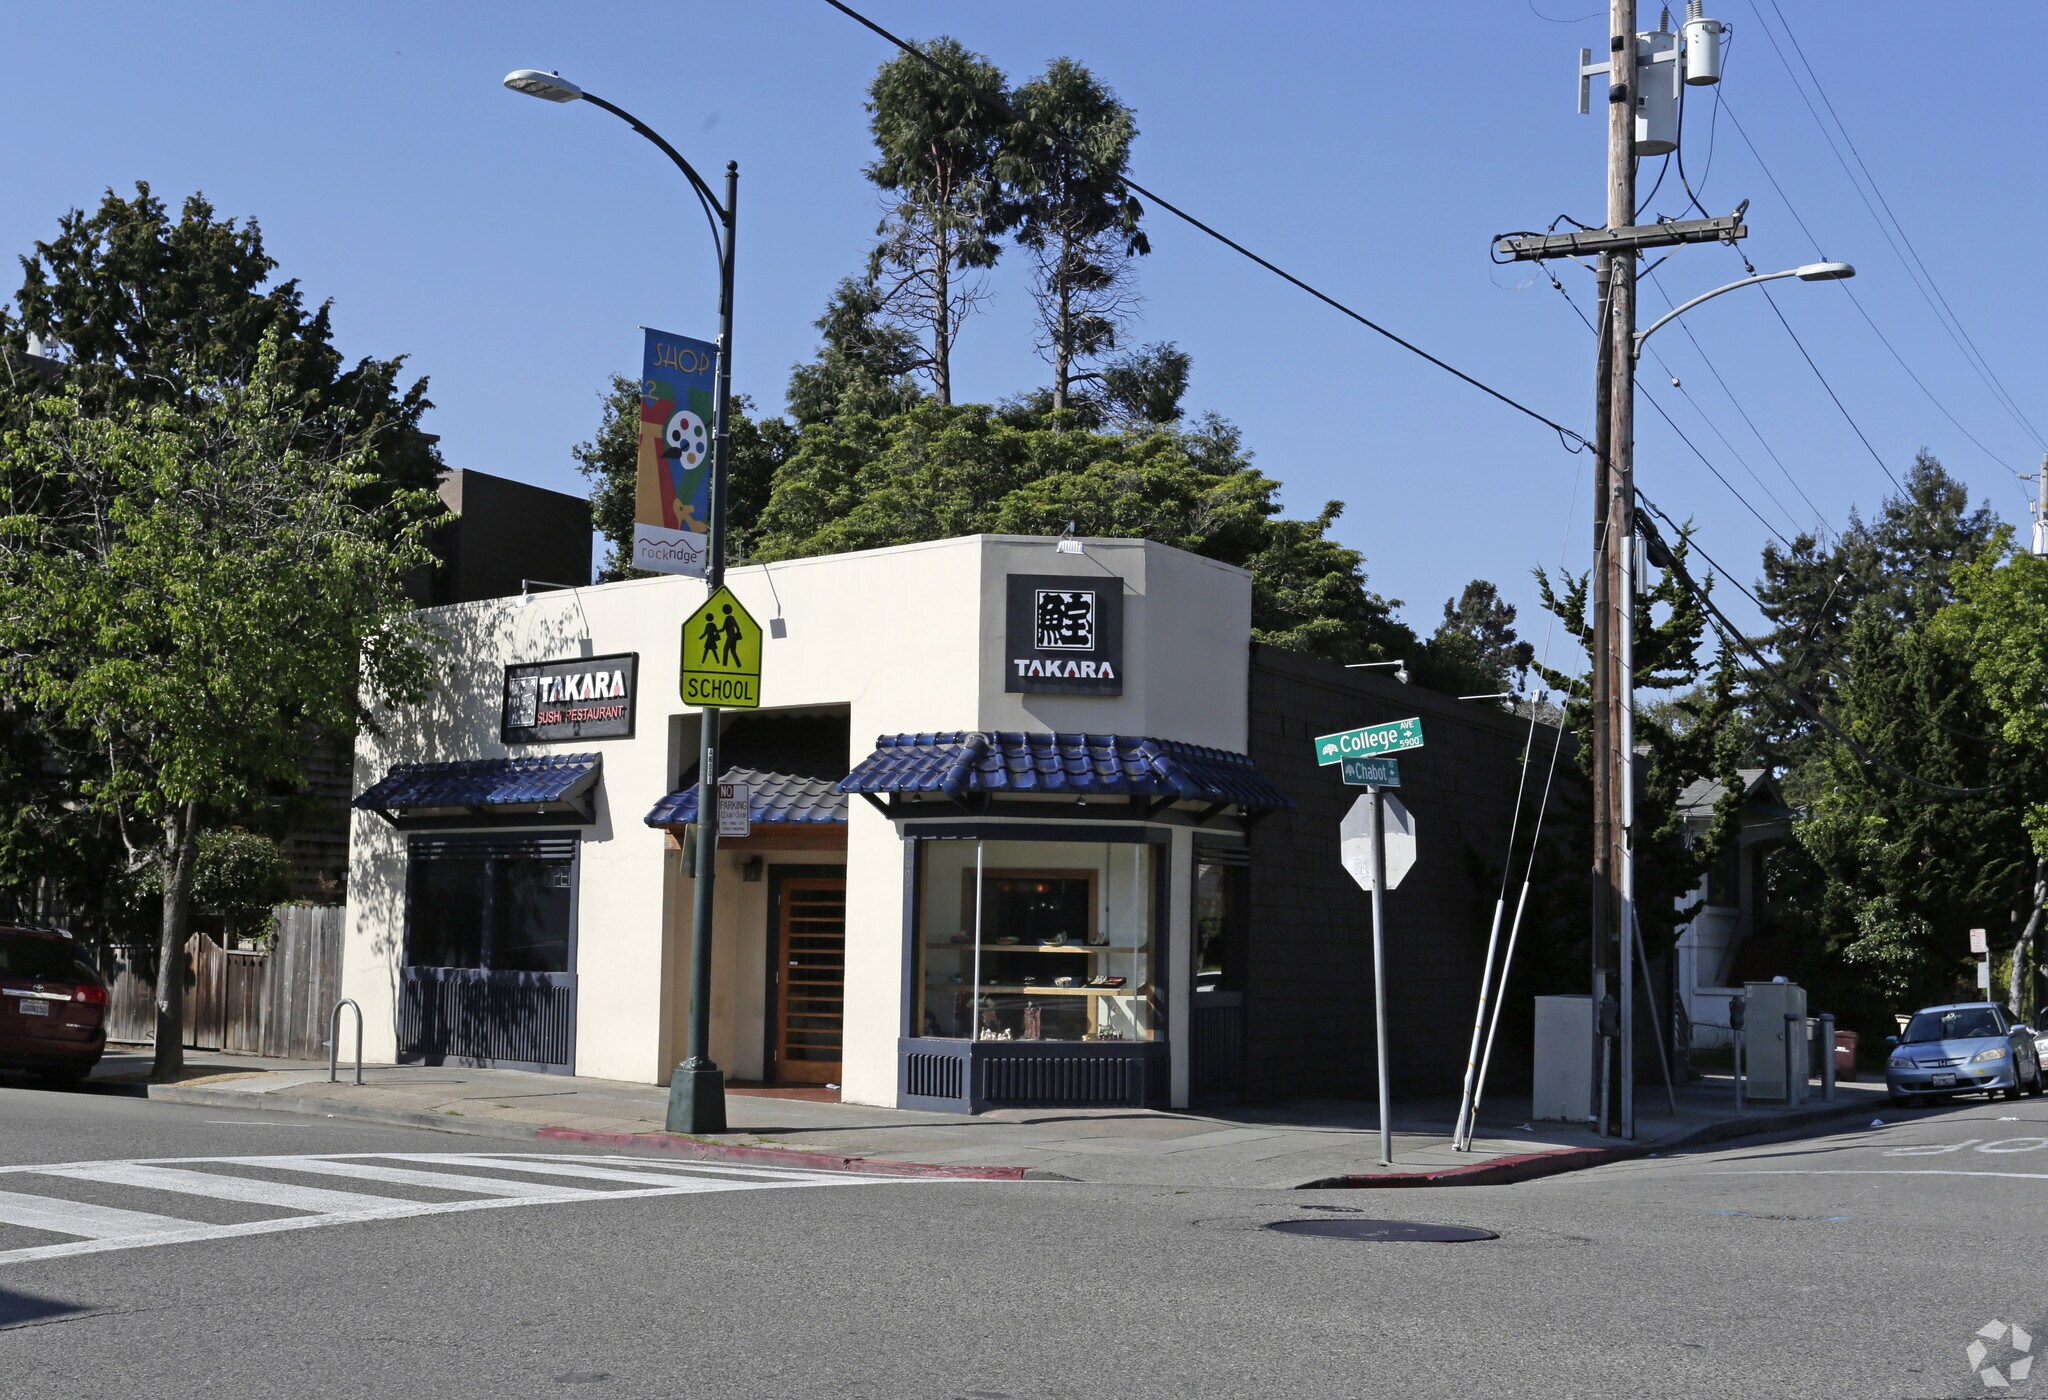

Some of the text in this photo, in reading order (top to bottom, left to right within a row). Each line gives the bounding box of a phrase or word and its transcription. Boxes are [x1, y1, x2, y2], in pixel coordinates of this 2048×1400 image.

[653, 343, 710, 376] SHOP
[641, 547, 698, 564] rockridge
[1014, 659, 1115, 679] TAKARA
[539, 670, 625, 703] TAKARA
[687, 678, 753, 700] SCHOOL
[537, 705, 624, 724] SUSHI RESTAURANT
[1340, 720, 1414, 753] College AVE
[1400, 736, 1420, 748] 5900
[1355, 762, 1387, 781] Chabot
[720, 785, 733, 798] NO
[720, 801, 747, 810] PARKING
